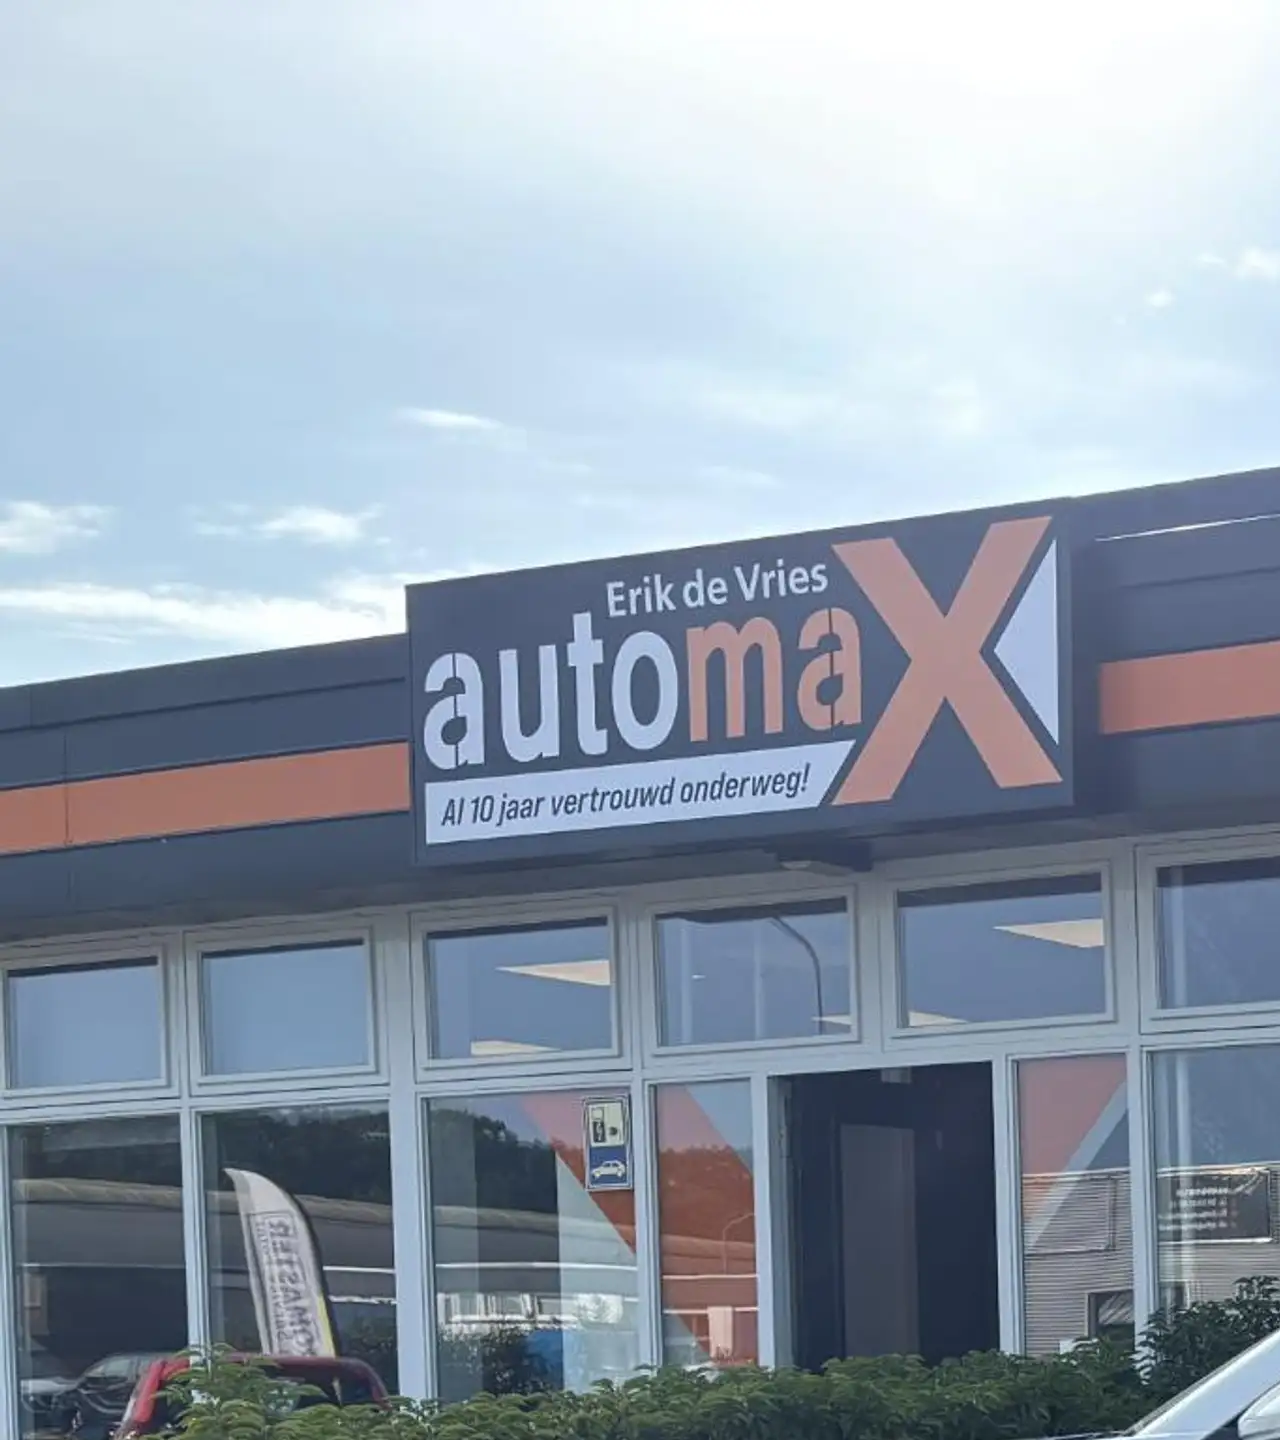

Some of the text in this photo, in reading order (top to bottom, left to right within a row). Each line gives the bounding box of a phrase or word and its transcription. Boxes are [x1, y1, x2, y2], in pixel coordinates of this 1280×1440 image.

[606, 560, 829, 617] Erik de Vries
[441, 762, 811, 826] Al 10 jaar vertrouwd onderweg!
